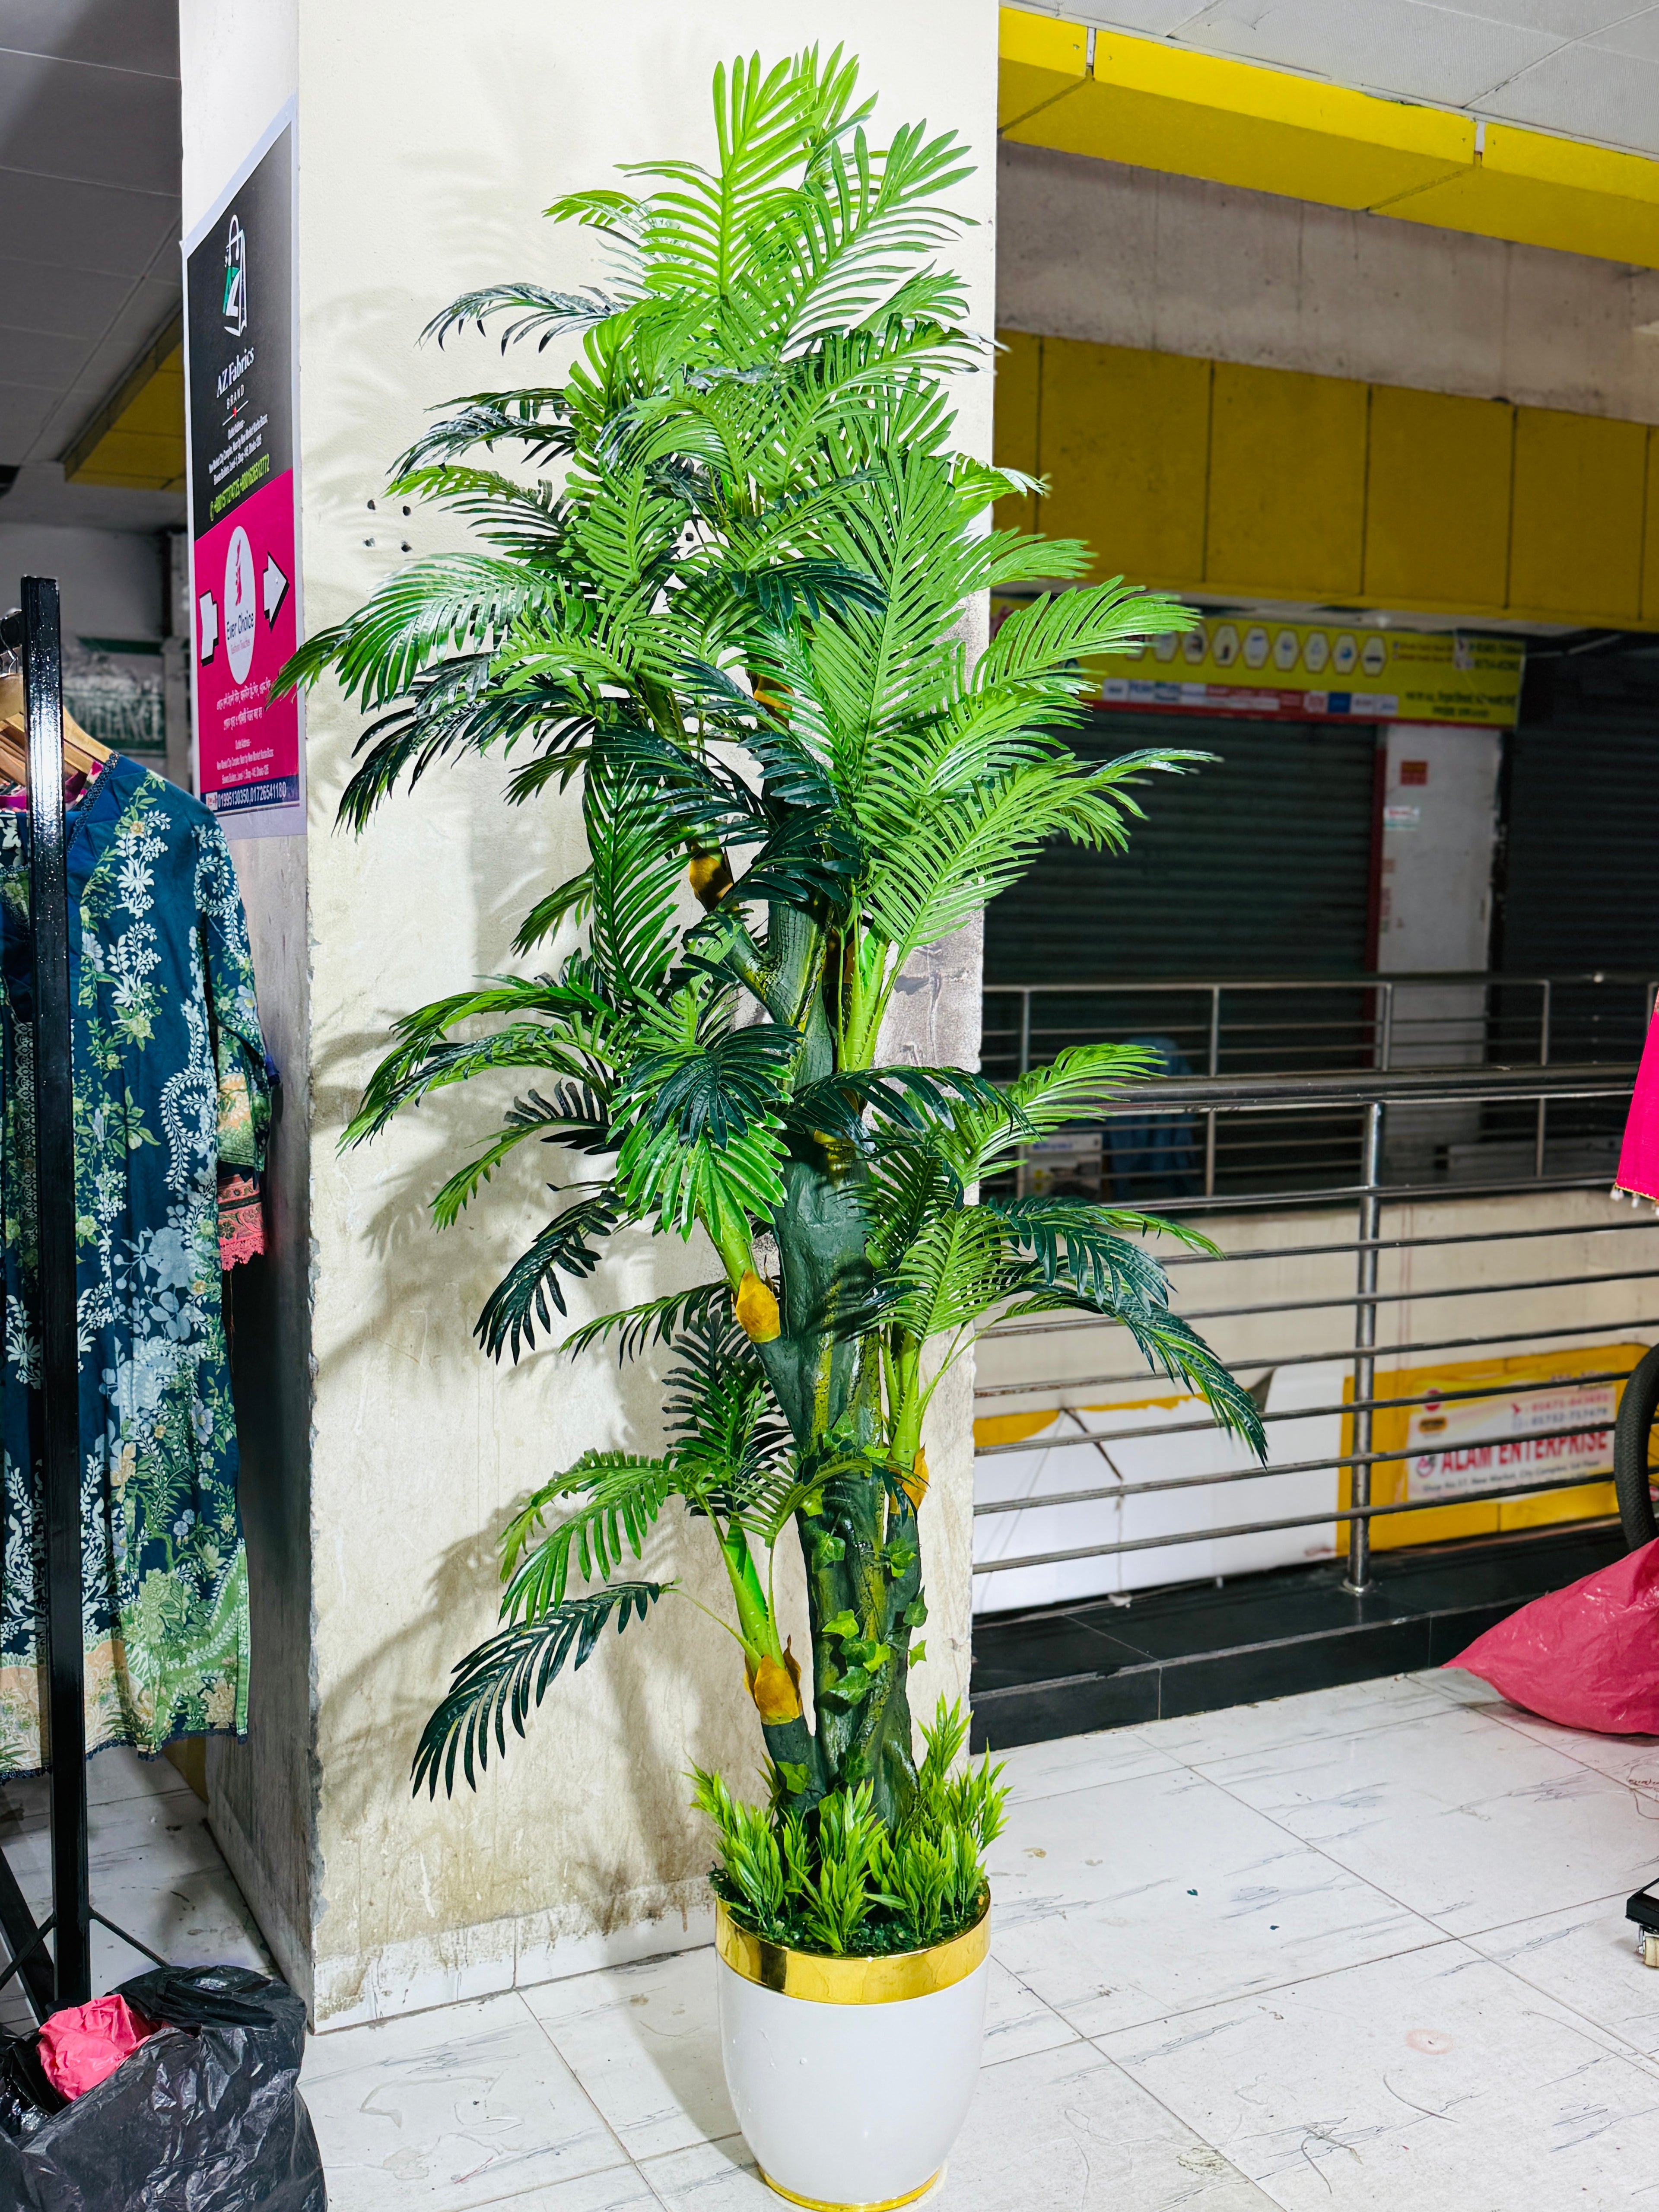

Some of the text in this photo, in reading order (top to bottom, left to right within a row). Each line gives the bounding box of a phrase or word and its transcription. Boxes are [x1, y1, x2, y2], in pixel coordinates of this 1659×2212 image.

[216, 347, 254, 398] AZ Fabrics
[226, 384, 245, 410] BRAND
[227, 610, 254, 640] Ever Choice
[1442, 1431, 1607, 1474] ALAM ENTERPRISE
